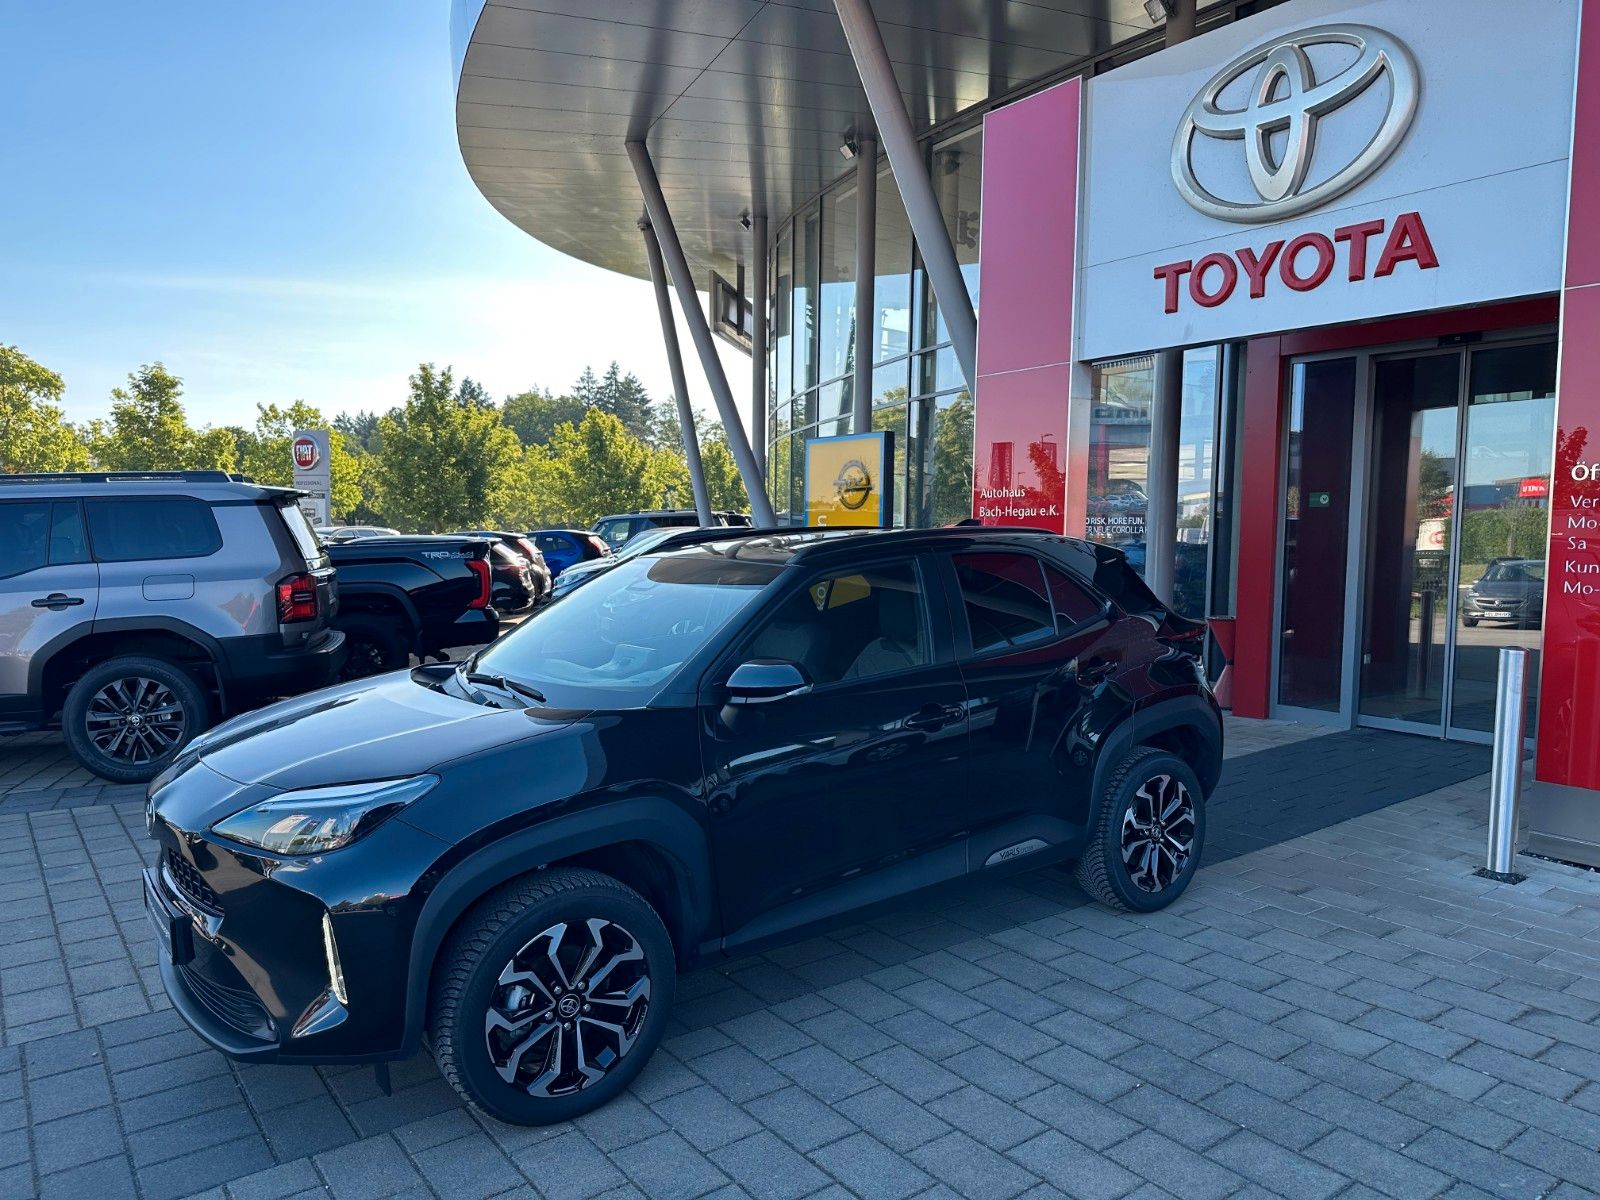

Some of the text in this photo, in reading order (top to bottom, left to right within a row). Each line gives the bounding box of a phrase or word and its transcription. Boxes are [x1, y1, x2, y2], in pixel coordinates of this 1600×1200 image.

[1153, 211, 1440, 315] TOYOTA
[295, 444, 313, 461] FIAT
[980, 486, 1026, 499] Autohaus
[1570, 494, 1600, 509] Ver
[979, 504, 1060, 520] Bach-Hegau e.K.
[1108, 516, 1128, 525] MORE
[1128, 516, 1145, 525] FUN.
[1111, 525, 1144, 534] COROLLA
[1567, 536, 1587, 550] Sa
[421, 551, 449, 560] TRD
[1565, 559, 1600, 574] Kun
[1563, 580, 1600, 595] Mo-
[1000, 847, 1020, 860] YARIS
